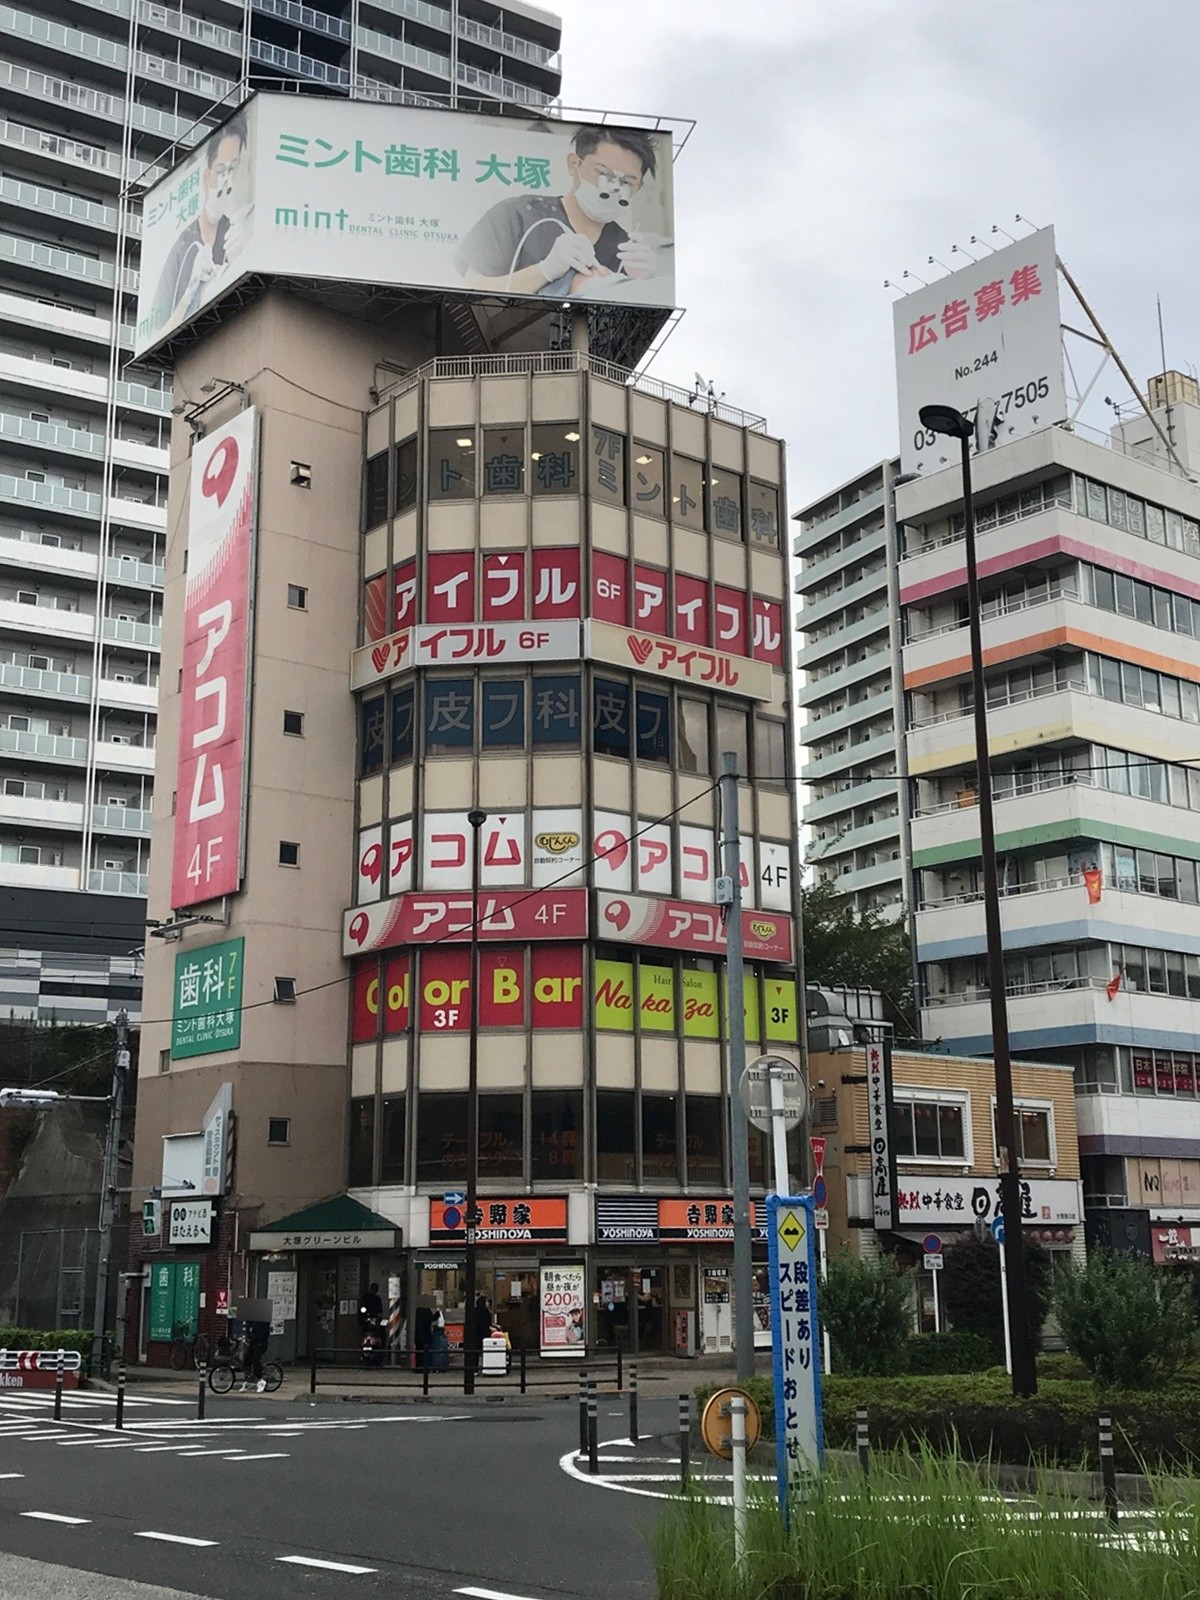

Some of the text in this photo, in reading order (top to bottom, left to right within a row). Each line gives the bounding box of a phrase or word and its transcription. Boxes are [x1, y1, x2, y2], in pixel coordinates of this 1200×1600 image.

[275, 133, 553, 190] ミント歯科 大塚
[274, 203, 349, 232] mint
[349, 223, 459, 242] DENTAL CLINIC OTSUKA
[368, 212, 415, 226] ミント歯科
[907, 264, 1043, 356] 広告募集
[954, 350, 999, 381] No.244
[395, 568, 577, 621] アイフル
[596, 578, 622, 600] 6F
[635, 580, 782, 651] アイフル
[392, 628, 550, 668] アイフル 6F
[654, 640, 740, 687] アイフル
[189, 599, 233, 823] アコム
[427, 688, 580, 733] 皮フ科
[186, 836, 224, 887] 4F
[391, 837, 522, 878] アコム
[761, 863, 788, 888] 4F
[412, 898, 567, 936] アコム 4F
[179, 956, 225, 1010] 歯科
[493, 967, 582, 1004] Bar
[176, 1006, 236, 1034] ミント歯科大塚
[433, 1009, 460, 1028] 3F
[770, 1007, 789, 1024] 3F
[687, 1203, 735, 1225] 吉野家
[171, 1225, 200, 1239] ほたえる
[283, 1234, 362, 1246] 大塚グリーンビル
[602, 1227, 654, 1239] YOSHINOYA
[686, 1228, 735, 1238] YOSHINOYA
[423, 1262, 459, 1270] YOSHINOYA
[543, 1271, 582, 1282] 朝食べたら
[793, 1260, 811, 1370] 段差あり
[778, 1262, 800, 1460] スピードおとせ
